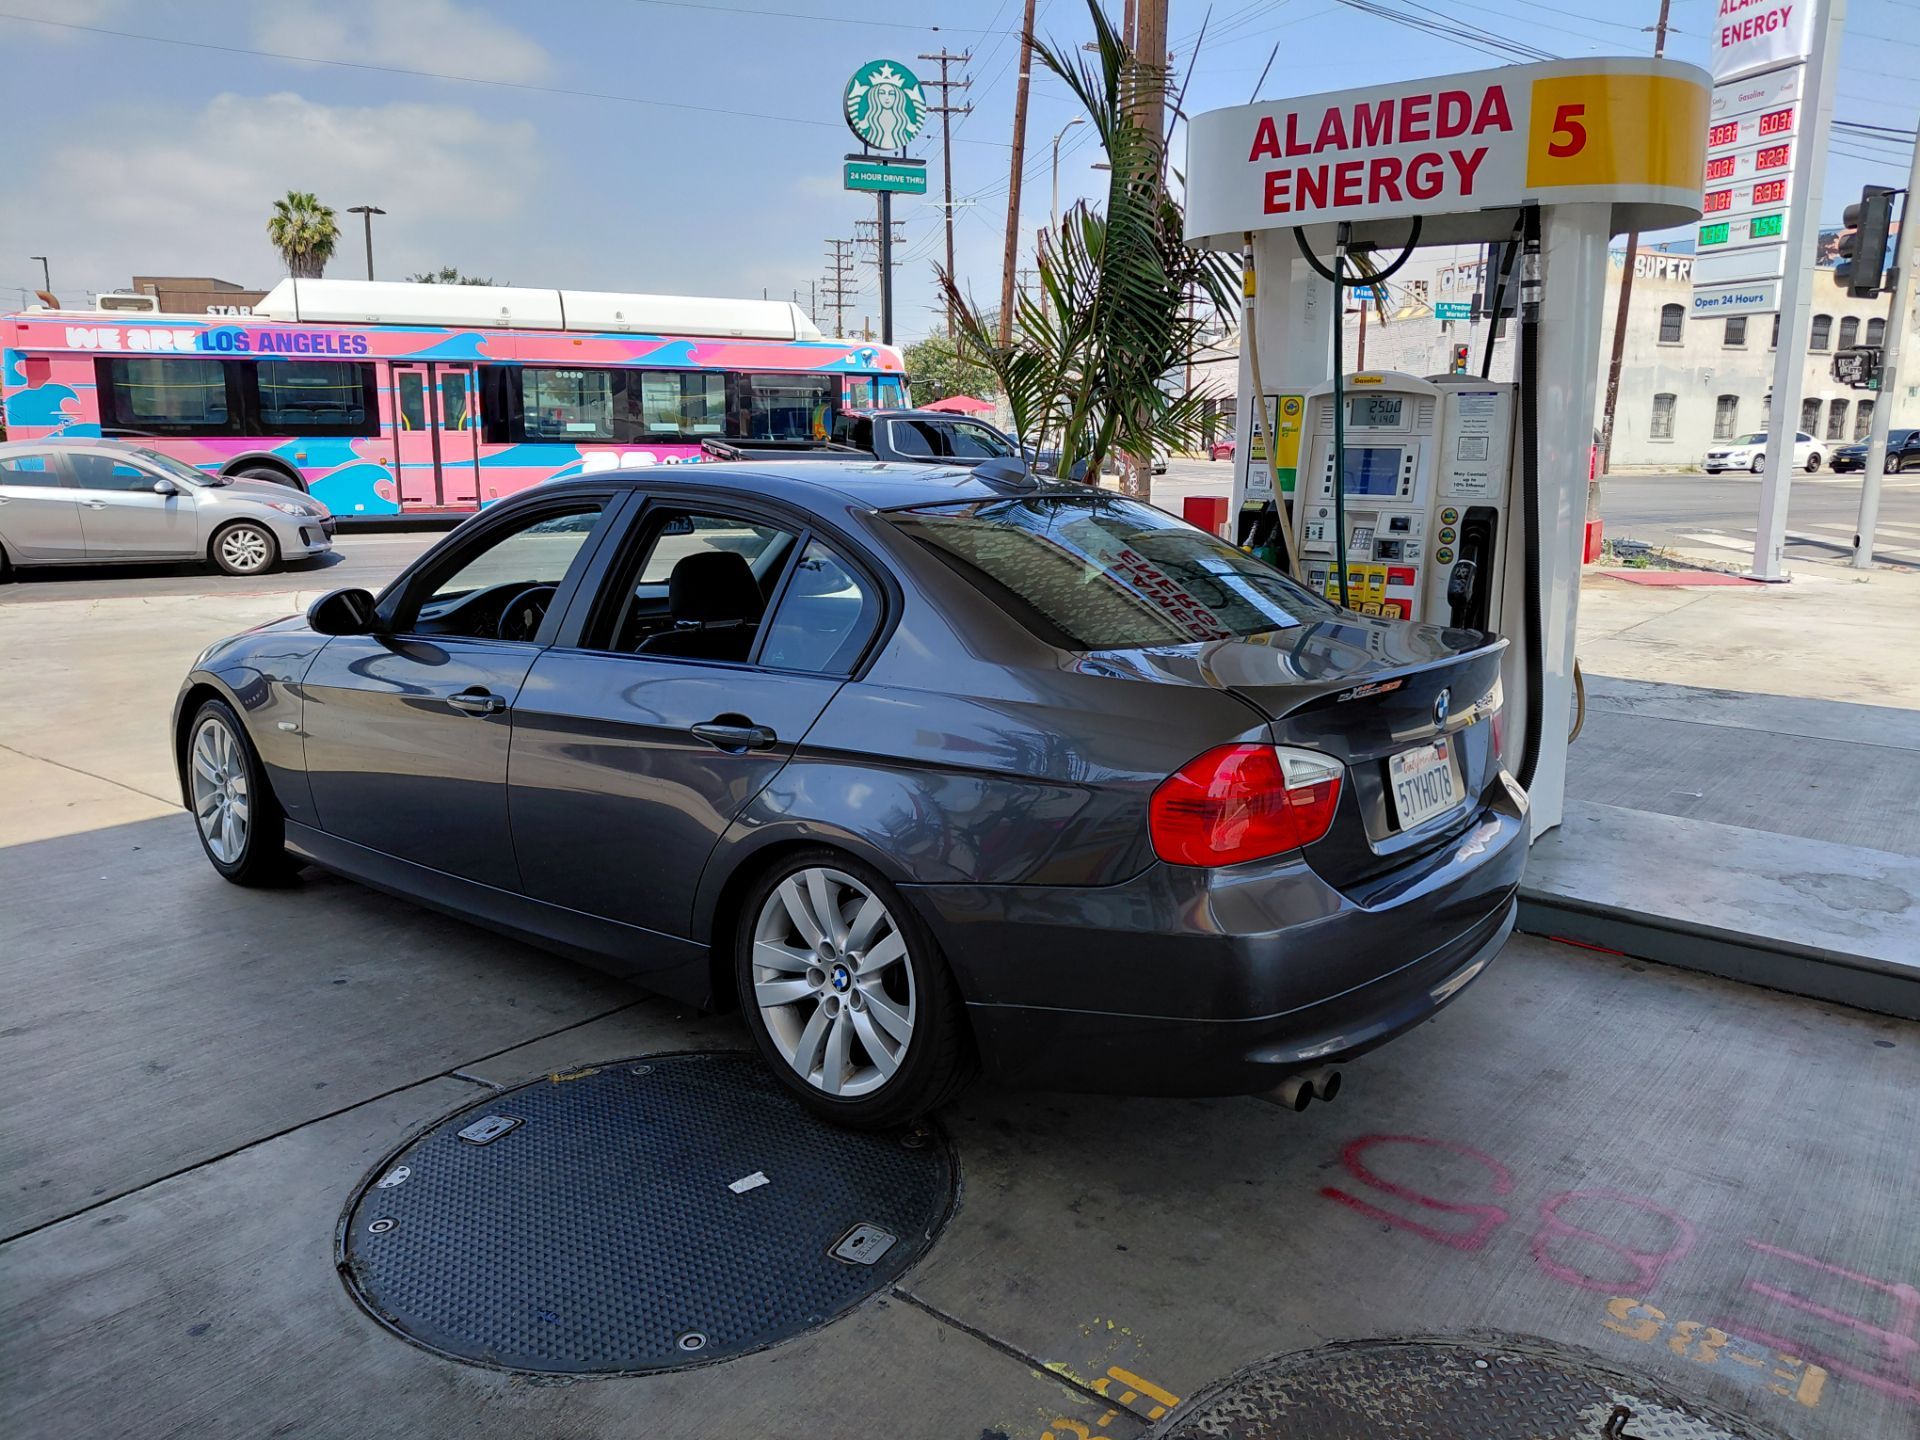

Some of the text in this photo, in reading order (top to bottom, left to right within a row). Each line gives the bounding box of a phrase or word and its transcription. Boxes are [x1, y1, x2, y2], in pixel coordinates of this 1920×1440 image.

[1721, 5, 1792, 48] ENERGY
[1738, 90, 1765, 102] Gasoline
[1249, 85, 1513, 162] ALAMEDA
[1547, 104, 1587, 158] 5
[860, 173, 881, 181] HOUR
[883, 175, 904, 183] DRIVE
[906, 176, 924, 184] THRU
[1263, 147, 1489, 215] ENERGY
[1634, 255, 1694, 281] SUPER
[206, 305, 256, 316] STAR
[1695, 294, 1763, 309] Open 24 Hours
[65, 327, 120, 350] WE
[201, 331, 249, 352] LOS
[258, 332, 368, 354] ANGELES
[1397, 765, 1452, 817] 5TYH078
